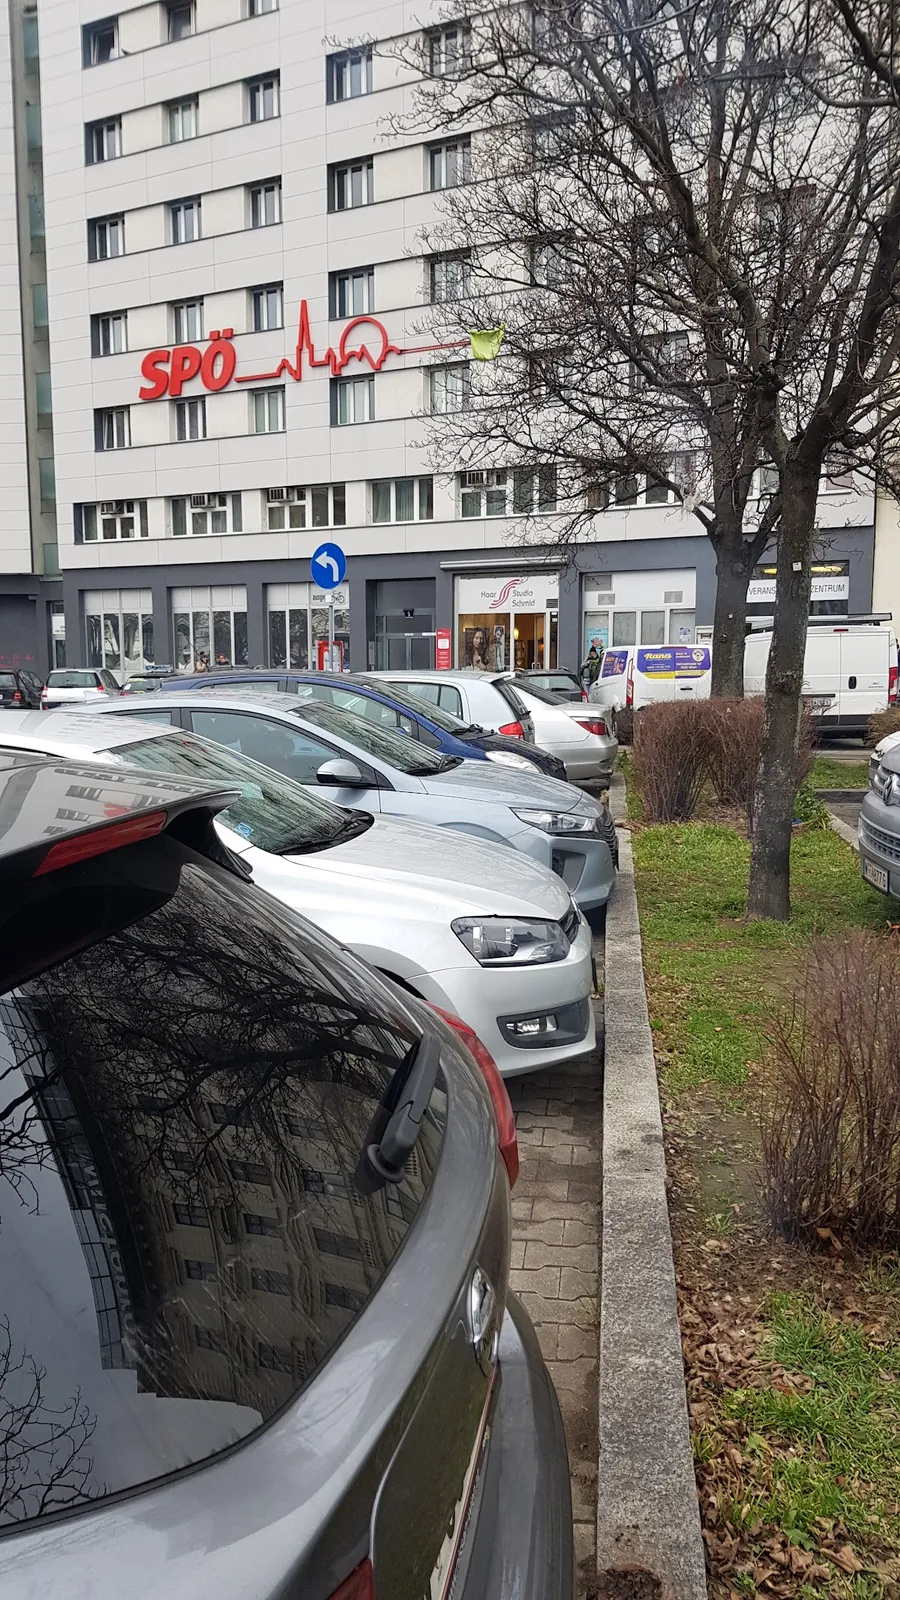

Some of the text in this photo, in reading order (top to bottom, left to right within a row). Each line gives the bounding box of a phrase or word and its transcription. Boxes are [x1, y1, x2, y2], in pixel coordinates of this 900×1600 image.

[139, 328, 237, 401] SPÖ
[480, 589, 534, 599] Haar Studio
[511, 599, 536, 607] Schmid
